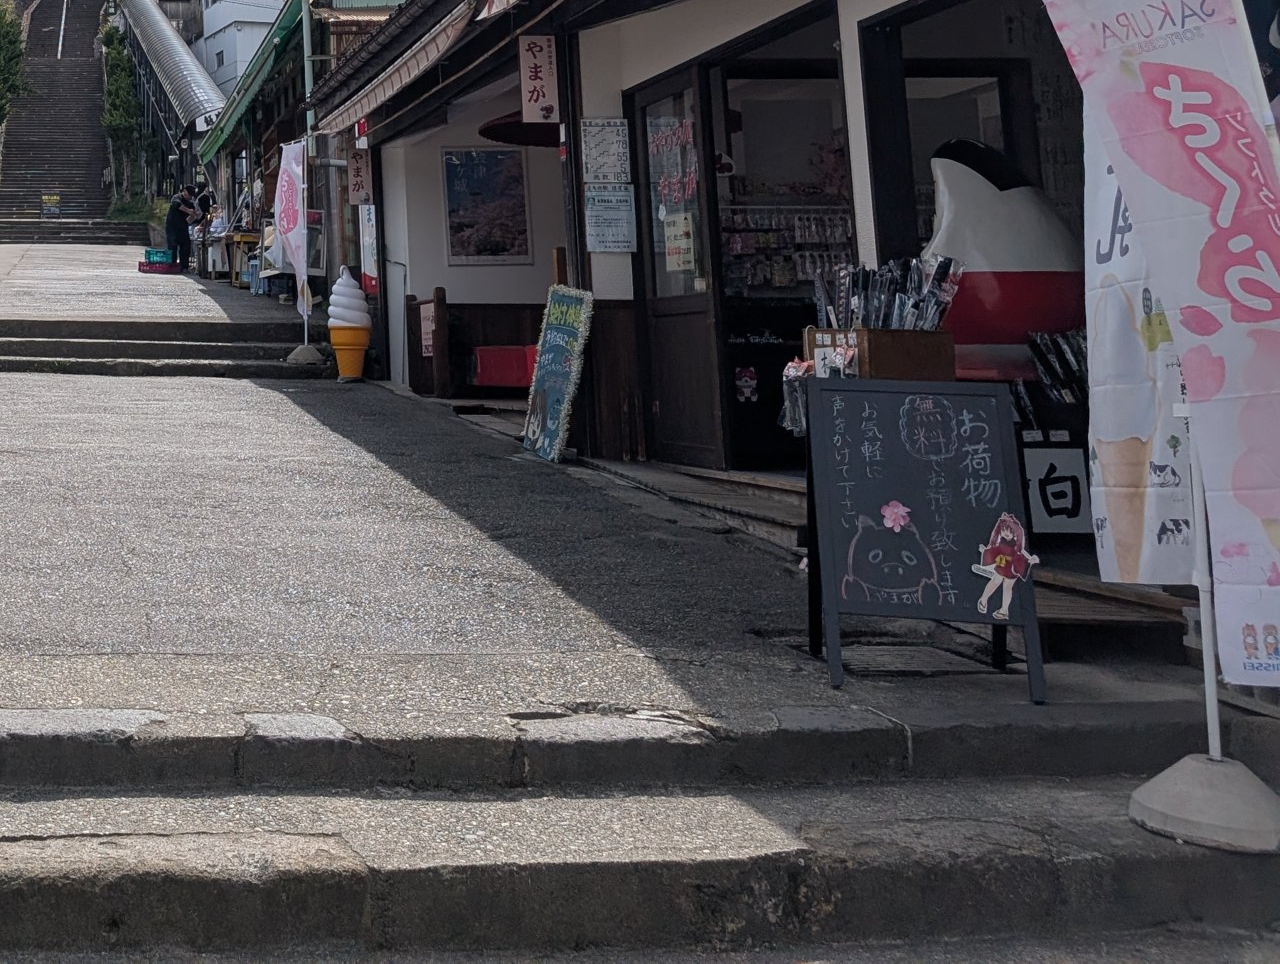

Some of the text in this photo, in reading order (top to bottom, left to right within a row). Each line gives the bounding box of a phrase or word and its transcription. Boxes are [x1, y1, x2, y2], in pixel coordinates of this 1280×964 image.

[525, 41, 546, 104] やまが
[615, 128, 627, 138] 45
[615, 140, 628, 149] 78
[616, 152, 628, 162] 55
[620, 163, 627, 173] 5
[350, 152, 364, 192] やまが
[613, 172, 629, 181] 183
[861, 400, 885, 479] お気軽に
[831, 394, 859, 529] 声をかけて下さい
[959, 408, 1002, 509] お荷物
